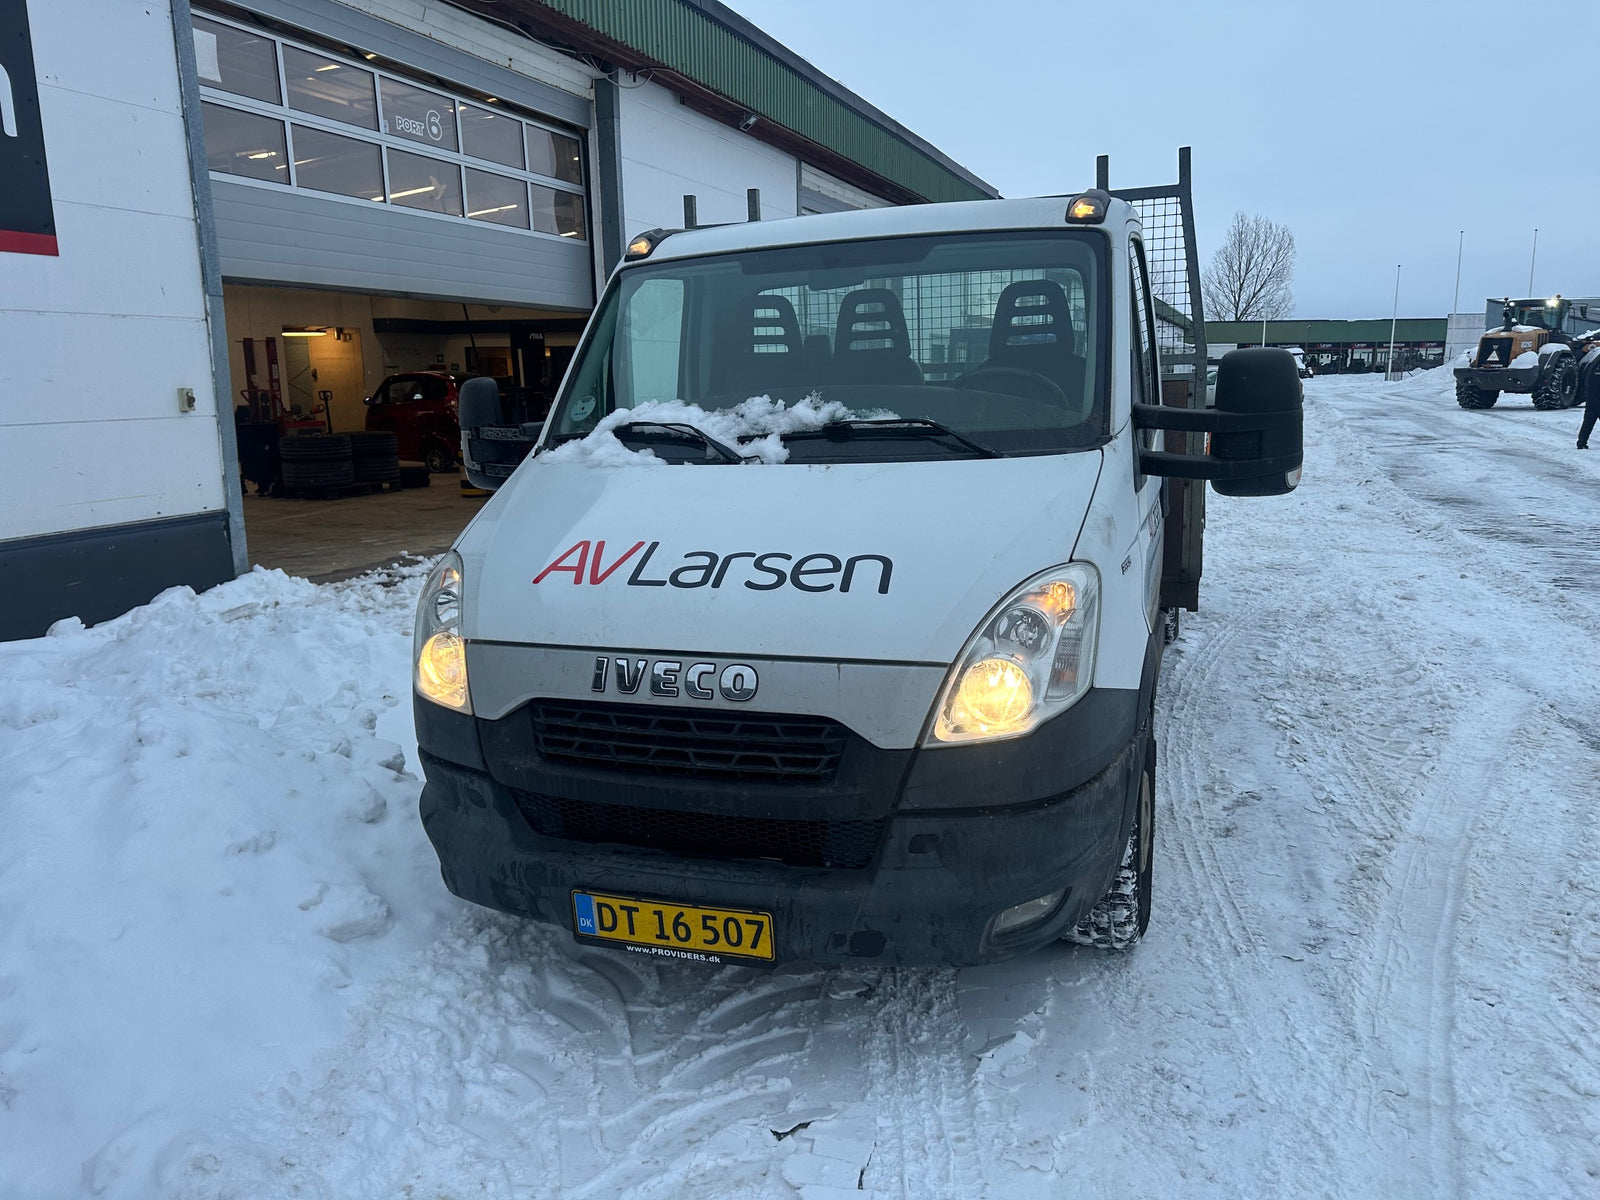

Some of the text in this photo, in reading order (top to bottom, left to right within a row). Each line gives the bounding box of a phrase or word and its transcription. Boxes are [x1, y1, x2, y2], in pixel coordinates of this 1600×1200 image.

[395, 109, 443, 141] PORT 6
[591, 655, 760, 702] IVECO
[579, 917, 593, 928] DK
[596, 901, 765, 950] DT 16 507
[625, 944, 722, 964] www.PROVIDERS.dk
